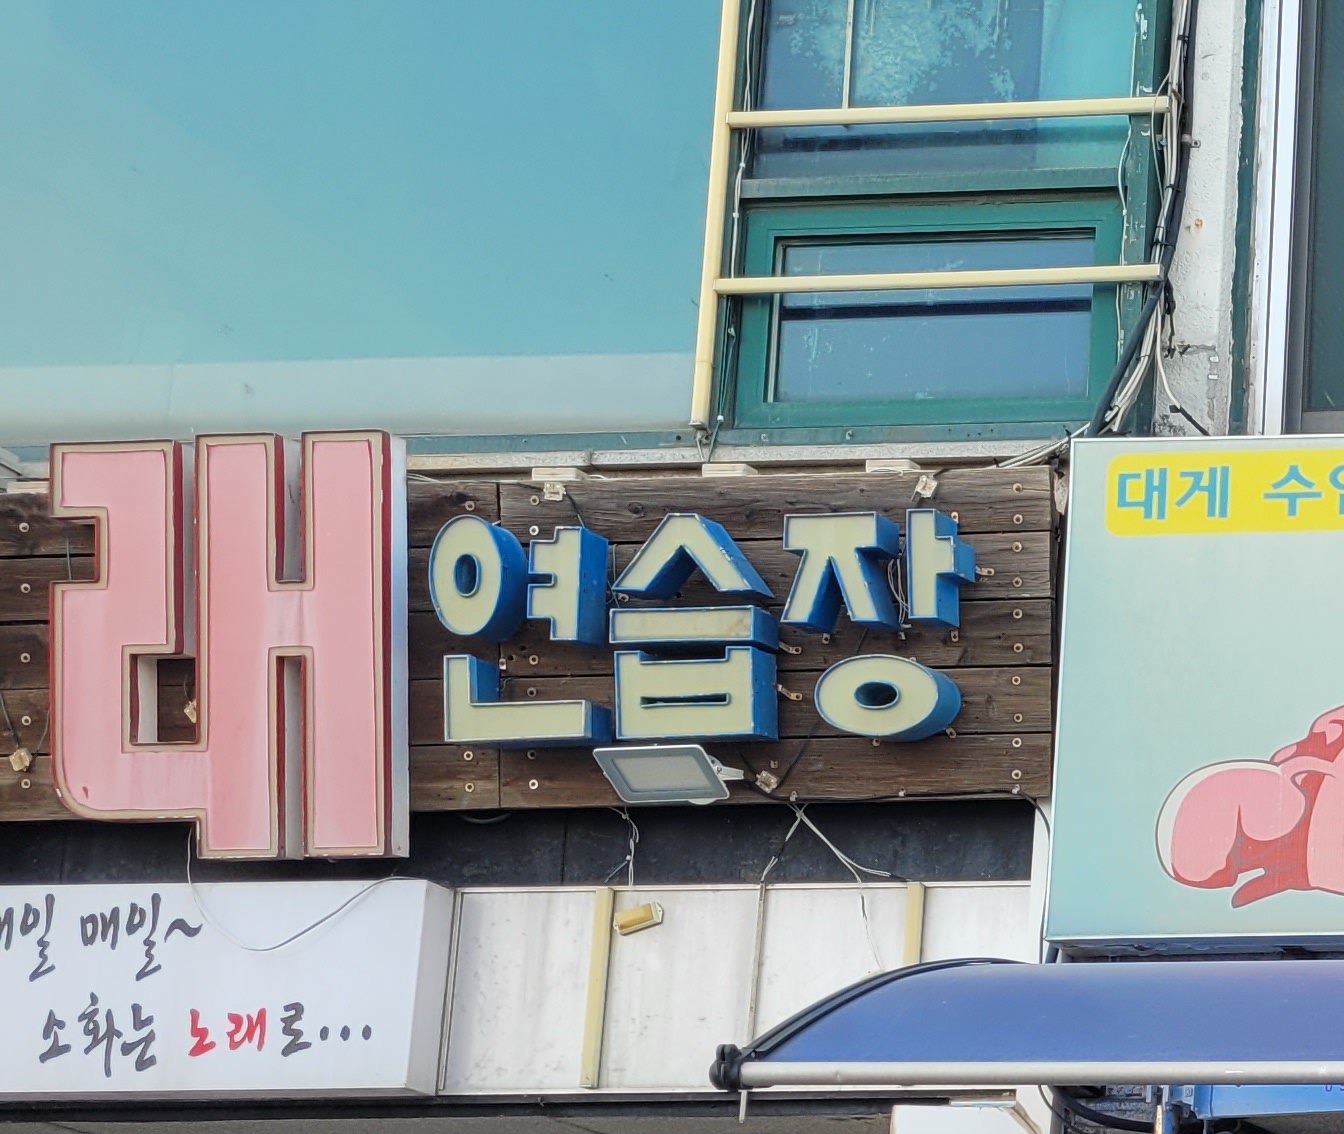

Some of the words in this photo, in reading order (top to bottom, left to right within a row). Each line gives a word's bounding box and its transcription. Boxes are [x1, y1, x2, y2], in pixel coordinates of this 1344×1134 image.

[1116, 465, 1230, 522] 대게
[51, 431, 406, 859] 래
[429, 508, 976, 745] 연습장
[40, 992, 157, 1077] 소화는
